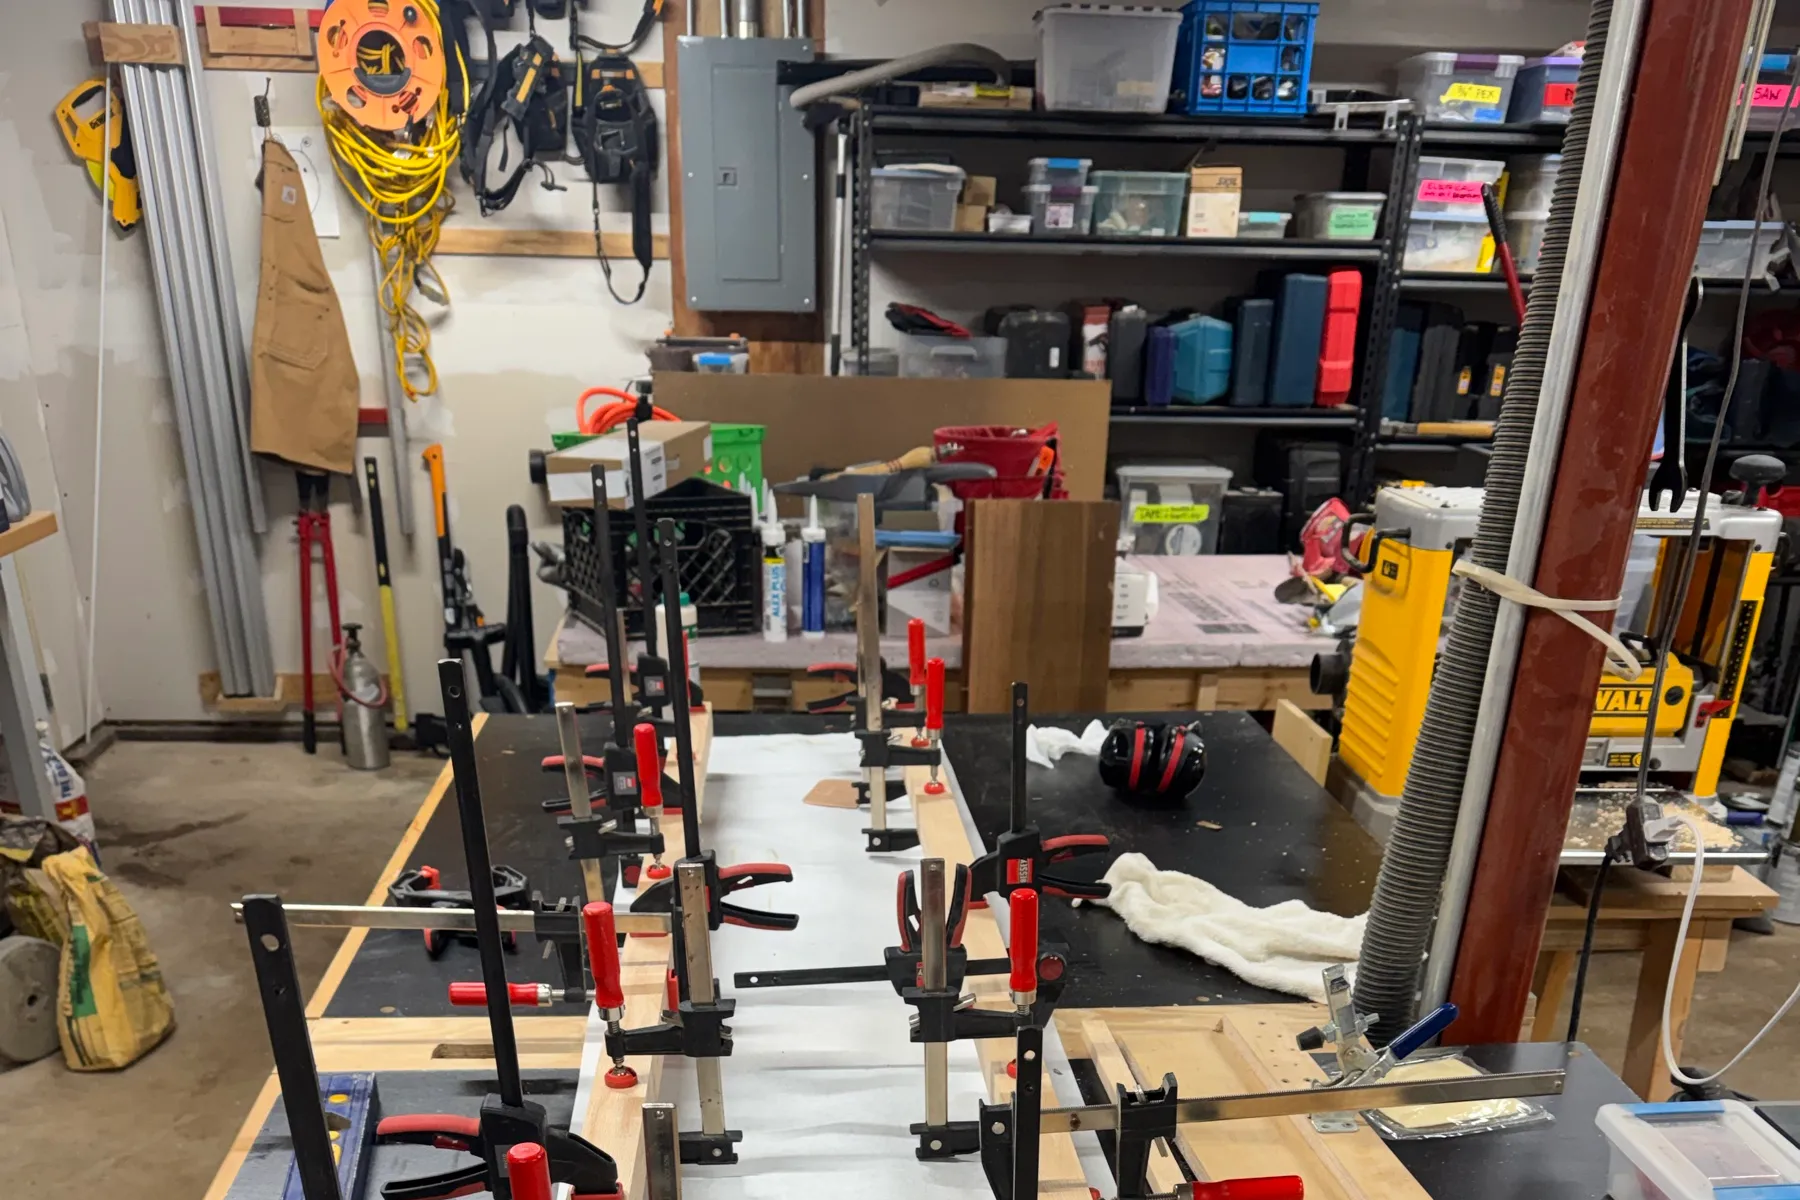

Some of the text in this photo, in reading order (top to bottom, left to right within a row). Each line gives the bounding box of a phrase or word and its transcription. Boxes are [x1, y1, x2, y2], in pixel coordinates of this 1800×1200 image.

[1753, 87, 1782, 101] SAW
[771, 566, 781, 617] ALEX PLUS
[1019, 858, 1029, 884] BESSEY
